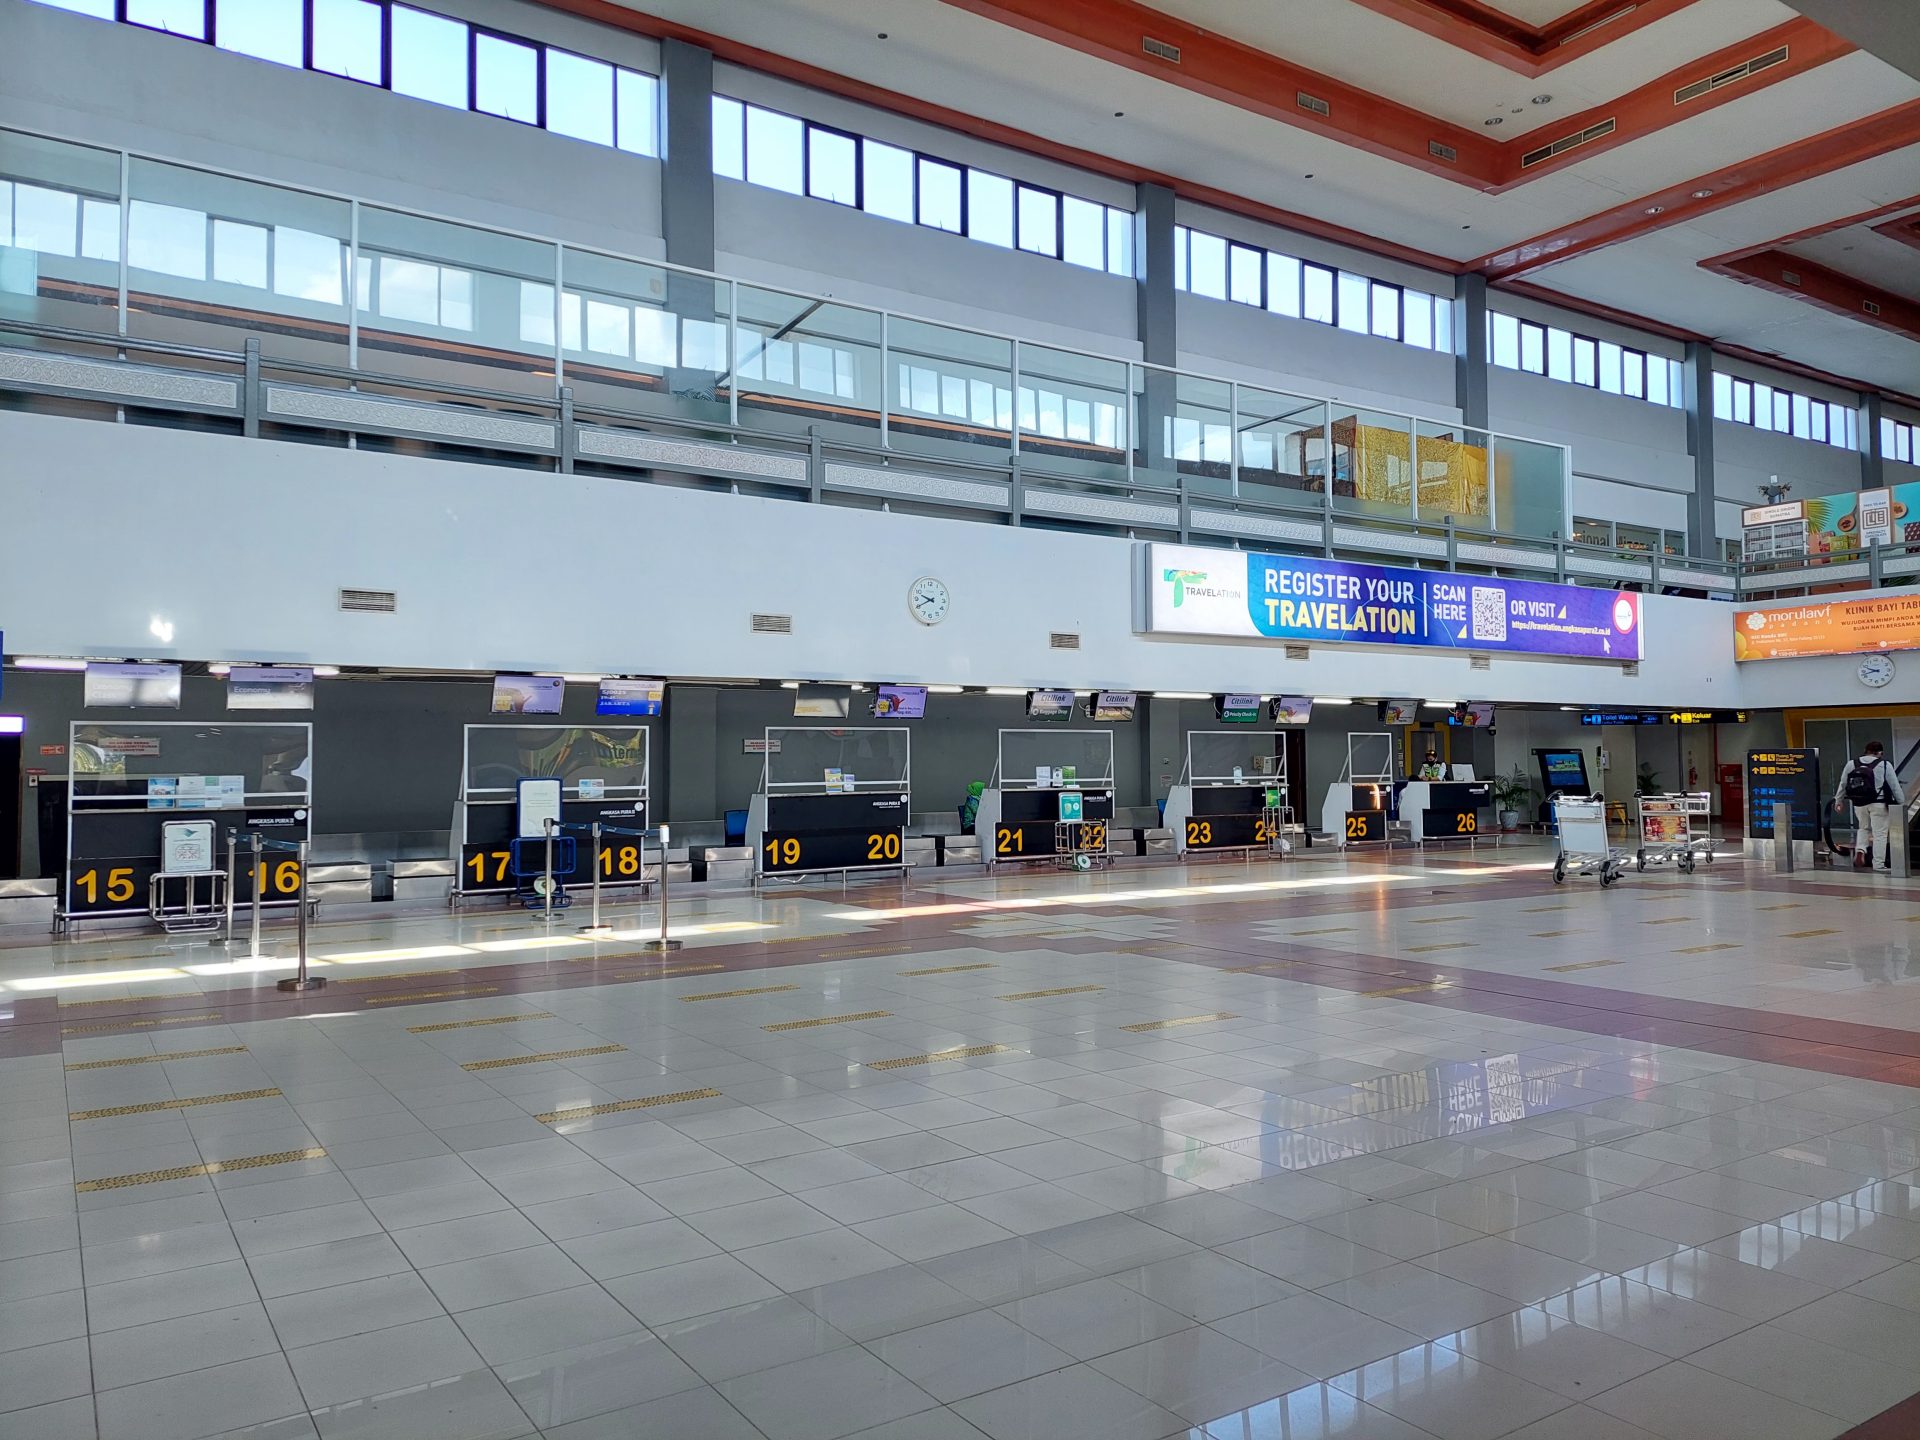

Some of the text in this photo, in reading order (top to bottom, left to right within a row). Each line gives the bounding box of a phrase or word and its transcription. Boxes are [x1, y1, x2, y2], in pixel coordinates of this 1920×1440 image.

[1186, 586, 1241, 600] TRAVELATION
[1265, 568, 1415, 604] REGISTER YOUR
[1432, 584, 1466, 602] SCAN
[1265, 598, 1416, 635] TRAVELATION
[1434, 603, 1467, 621] HERE
[1510, 600, 1556, 618] OR VISIT
[1768, 605, 1832, 622] morulaivf
[1846, 605, 1874, 615] KLINIK
[1877, 602, 1898, 612] BAYI
[234, 686, 271, 696] Economy
[1187, 822, 1212, 844] 23
[1255, 821, 1278, 841] 24
[1347, 817, 1367, 837] 25
[1457, 813, 1476, 832] 26
[868, 833, 900, 860] 20
[998, 828, 1023, 852] 21
[1080, 826, 1105, 849] 22
[599, 846, 638, 876] 18
[766, 838, 801, 866] 19
[248, 861, 300, 894] 16
[467, 851, 511, 883] 17
[76, 868, 135, 904] 15
